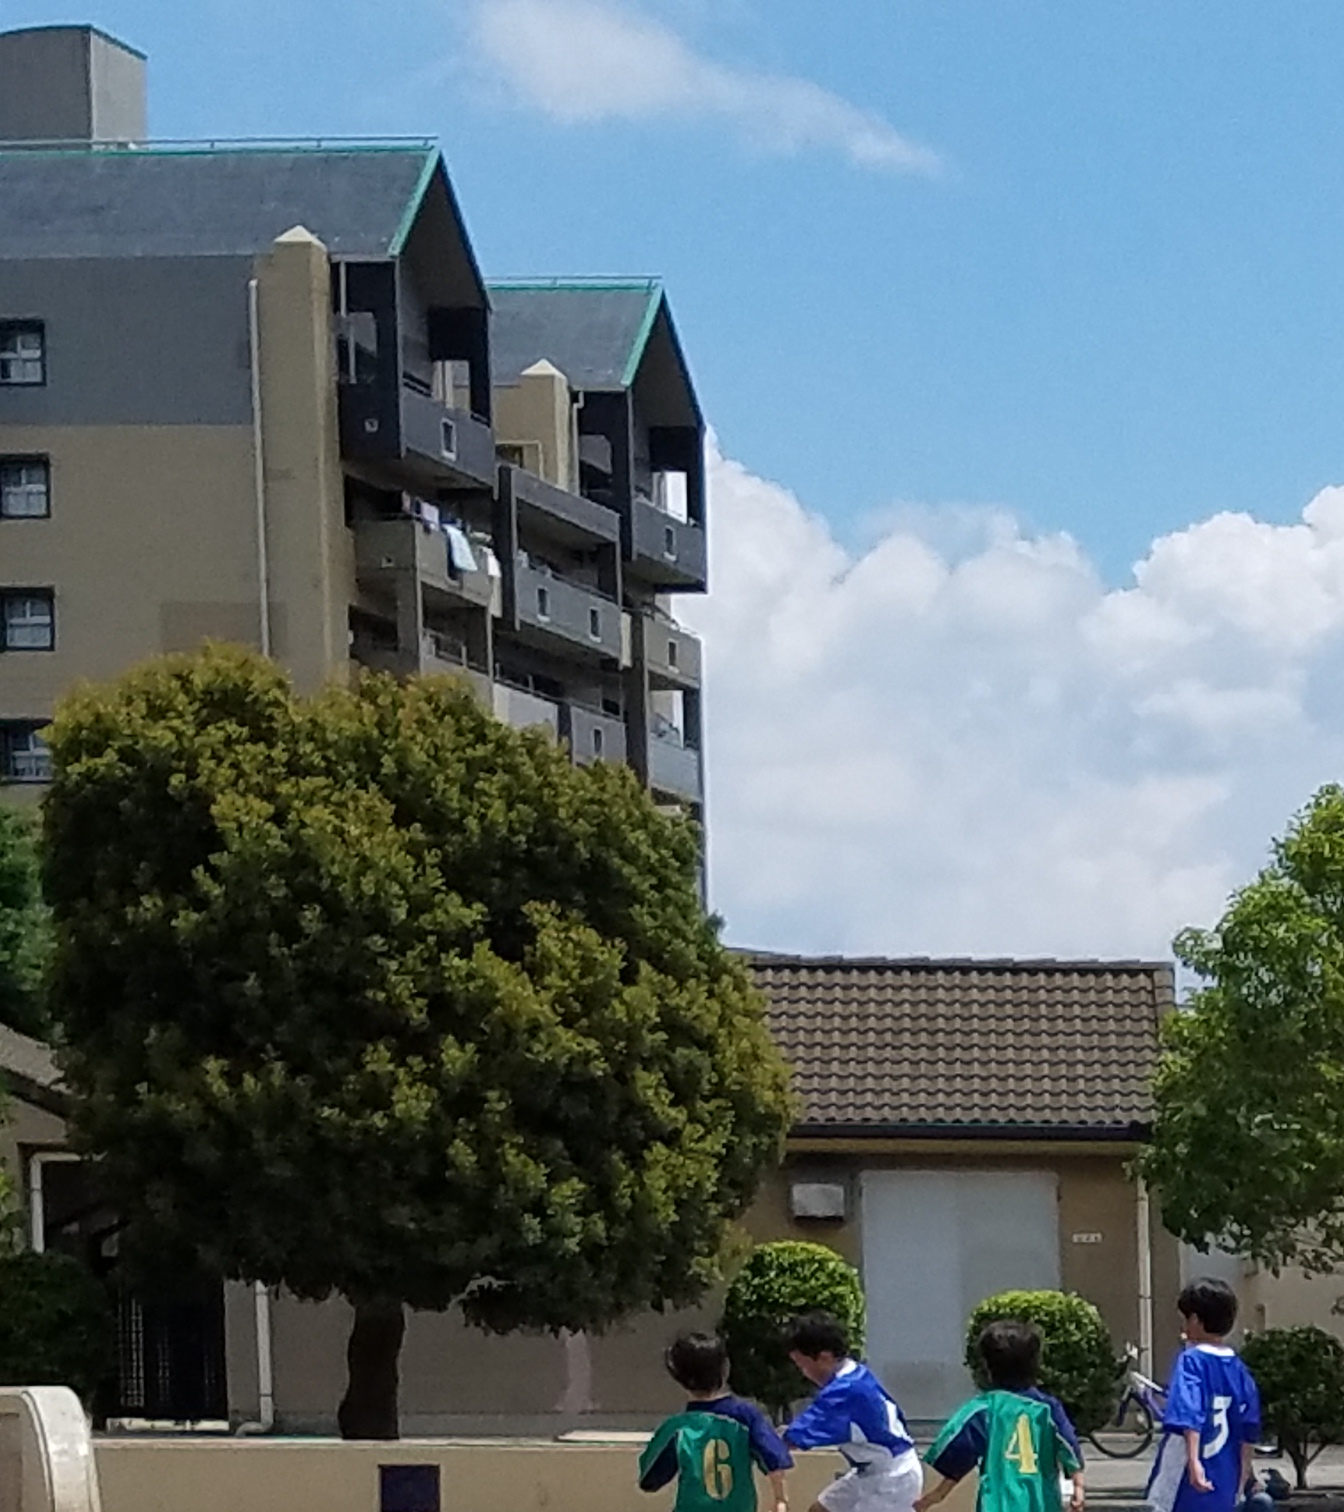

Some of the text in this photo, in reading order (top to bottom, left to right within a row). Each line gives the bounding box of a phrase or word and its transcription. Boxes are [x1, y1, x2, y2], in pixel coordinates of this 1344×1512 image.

[1005, 1414, 1039, 1474] 4
[1203, 1396, 1232, 1459] 3
[704, 1439, 733, 1500] 6
